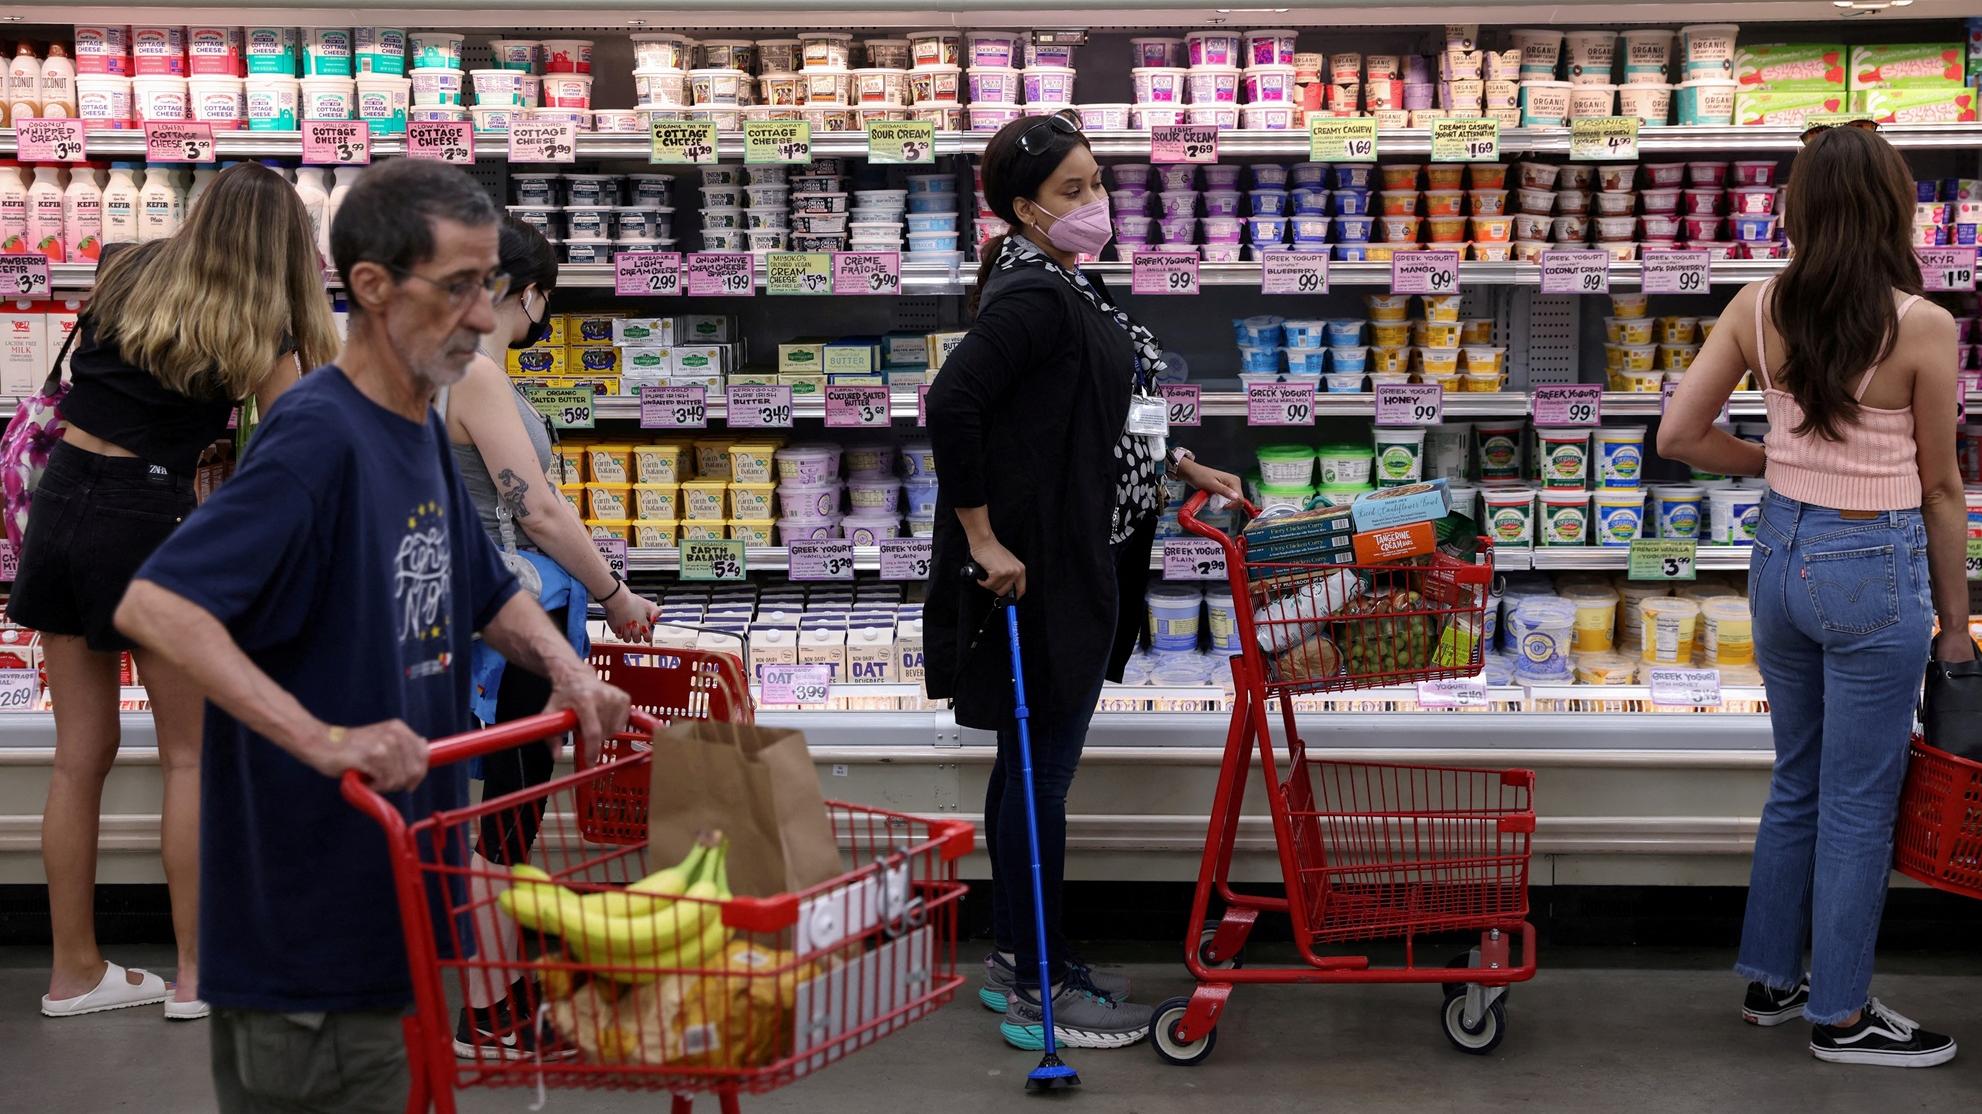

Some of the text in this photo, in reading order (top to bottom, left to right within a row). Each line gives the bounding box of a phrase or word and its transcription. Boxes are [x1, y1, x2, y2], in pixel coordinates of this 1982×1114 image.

[1526, 46, 1564, 55] ORGANIC
[410, 129, 462, 138] COTTAGE
[514, 128, 566, 137] COTTAGE
[656, 130, 707, 138] COTTAGE
[872, 130, 930, 140] SOUR CREAM
[1153, 132, 1216, 143] SOUR CREAM
[150, 140, 182, 148] CHEESE
[1135, 258, 1165, 266] GREEK
[1538, 391, 1567, 400] GREEK
[150, 464, 168, 474] ZARA
[1373, 531, 1410, 545] TANGERINE
[1381, 540, 1402, 551] CREAM
[1165, 548, 1225, 556] GREEK YOGURT
[903, 653, 924, 668] OA
[853, 662, 888, 677] OAT
